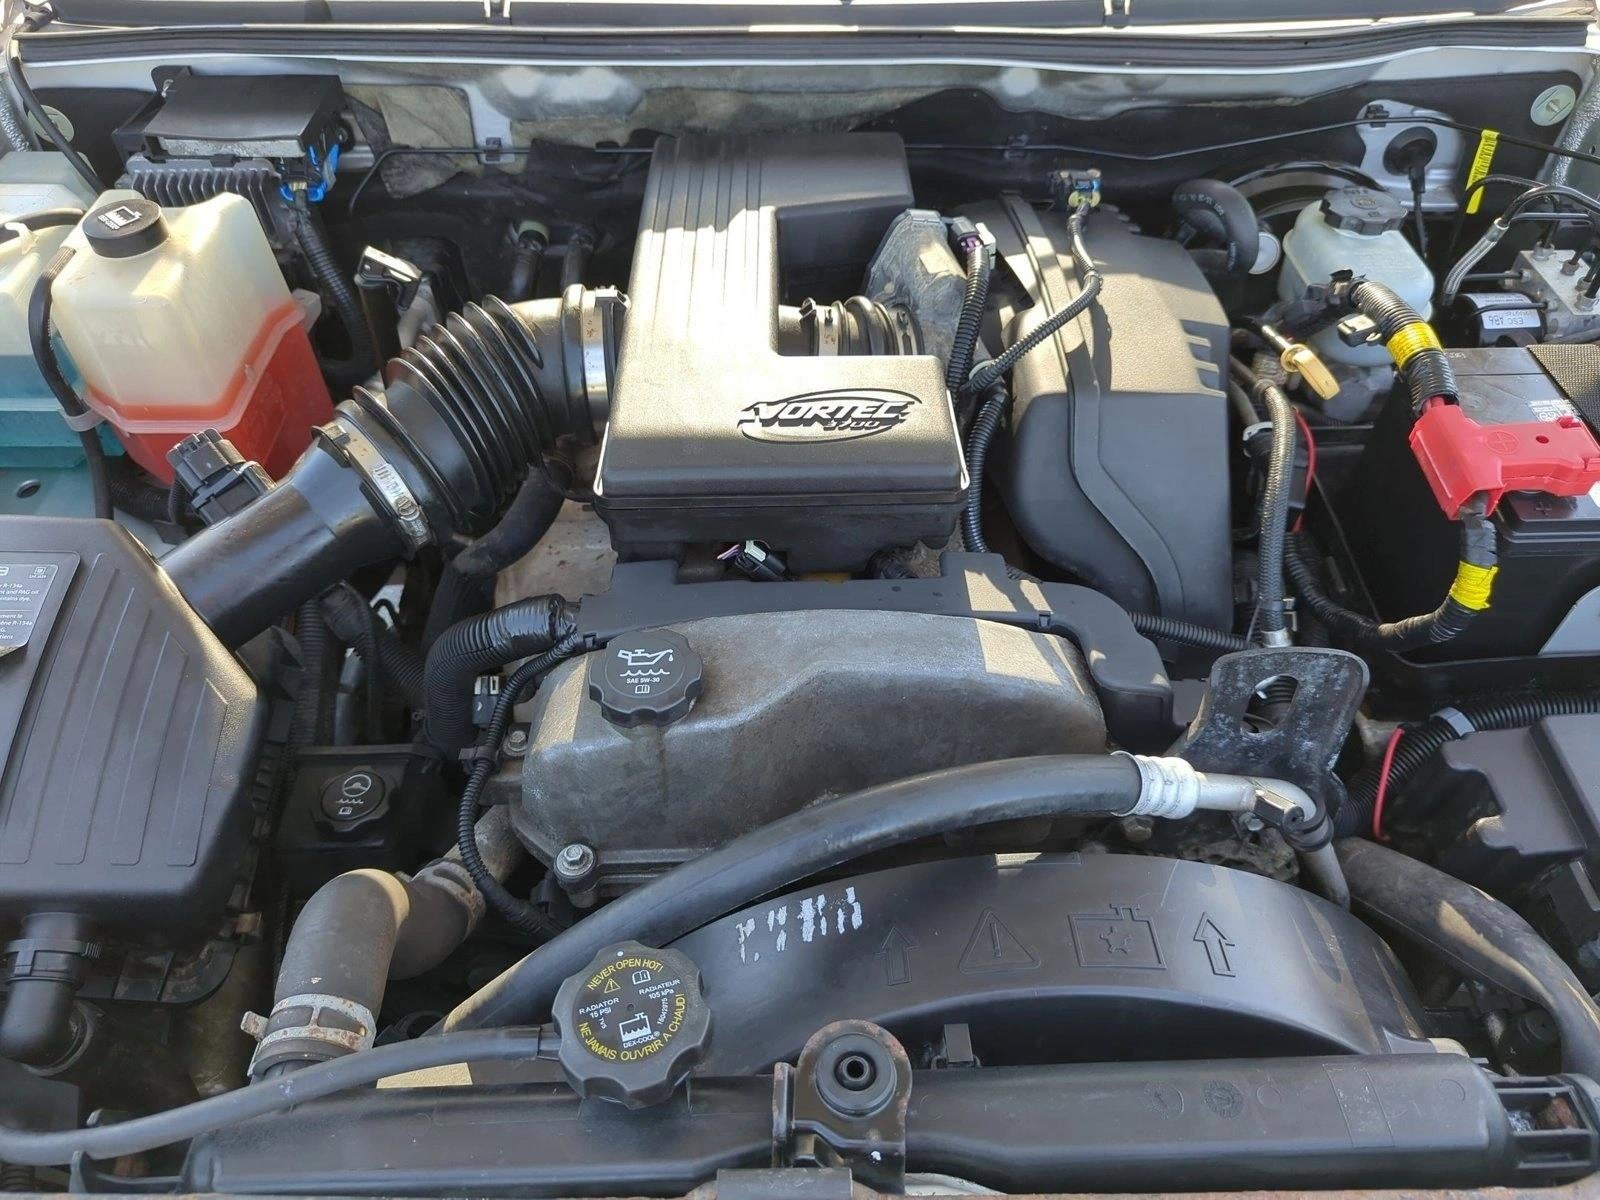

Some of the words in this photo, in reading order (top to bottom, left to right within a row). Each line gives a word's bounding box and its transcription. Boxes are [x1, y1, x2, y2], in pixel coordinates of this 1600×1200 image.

[752, 400, 915, 428] VORTEC
[587, 965, 616, 991] NEVER
[616, 958, 642, 970] OPEN
[642, 958, 664, 973] HOT!
[639, 979, 680, 994] RADIATEUR
[648, 991, 661, 1000] 105
[579, 997, 620, 1015] RADIATOR
[589, 1009, 599, 1019] 15
[599, 1007, 612, 1016] PSI
[668, 992, 686, 1032] CHAUD!
[579, 1021, 592, 1039] NE
[585, 1035, 618, 1060] JAMAIS
[620, 1040, 664, 1061] OUVRIR
